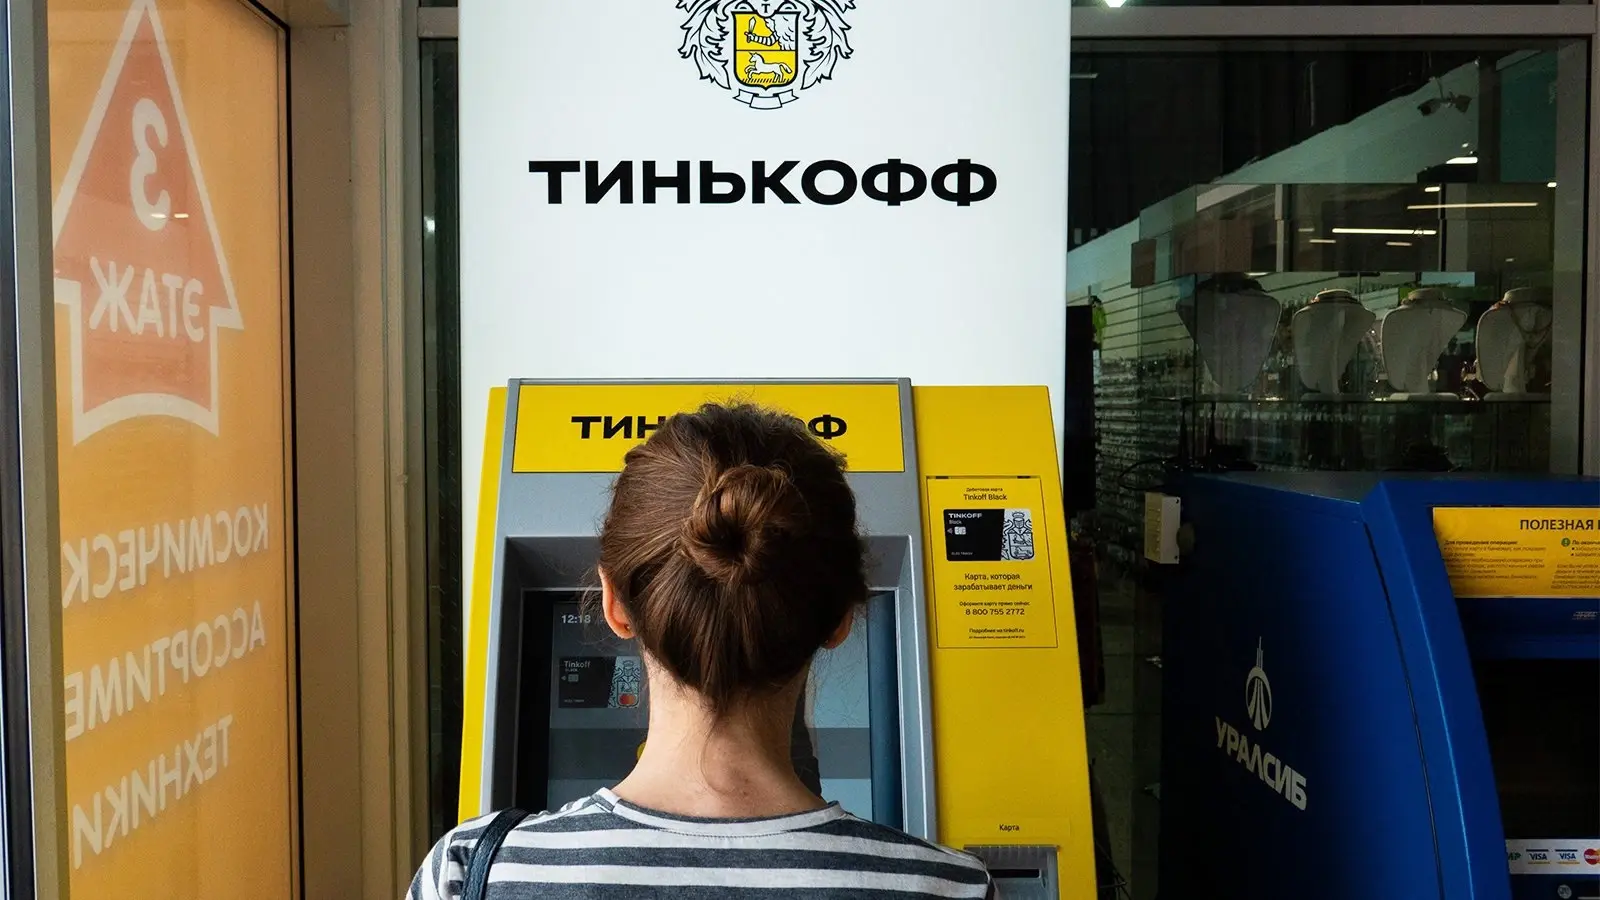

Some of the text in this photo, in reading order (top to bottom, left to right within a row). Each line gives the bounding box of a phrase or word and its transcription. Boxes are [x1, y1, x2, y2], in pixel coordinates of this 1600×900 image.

[528, 158, 997, 206] ТИНЬКОФФ
[571, 414, 847, 439] ТИНФ
[1520, 519, 1594, 530] ПОЛЕЗНАЯ
[965, 573, 989, 581] Карта,
[954, 583, 1005, 591] зарабатывает
[561, 615, 591, 624] 12:18
[1215, 715, 1307, 811] УРАЛСИБ
[999, 824, 1020, 832] Карта
